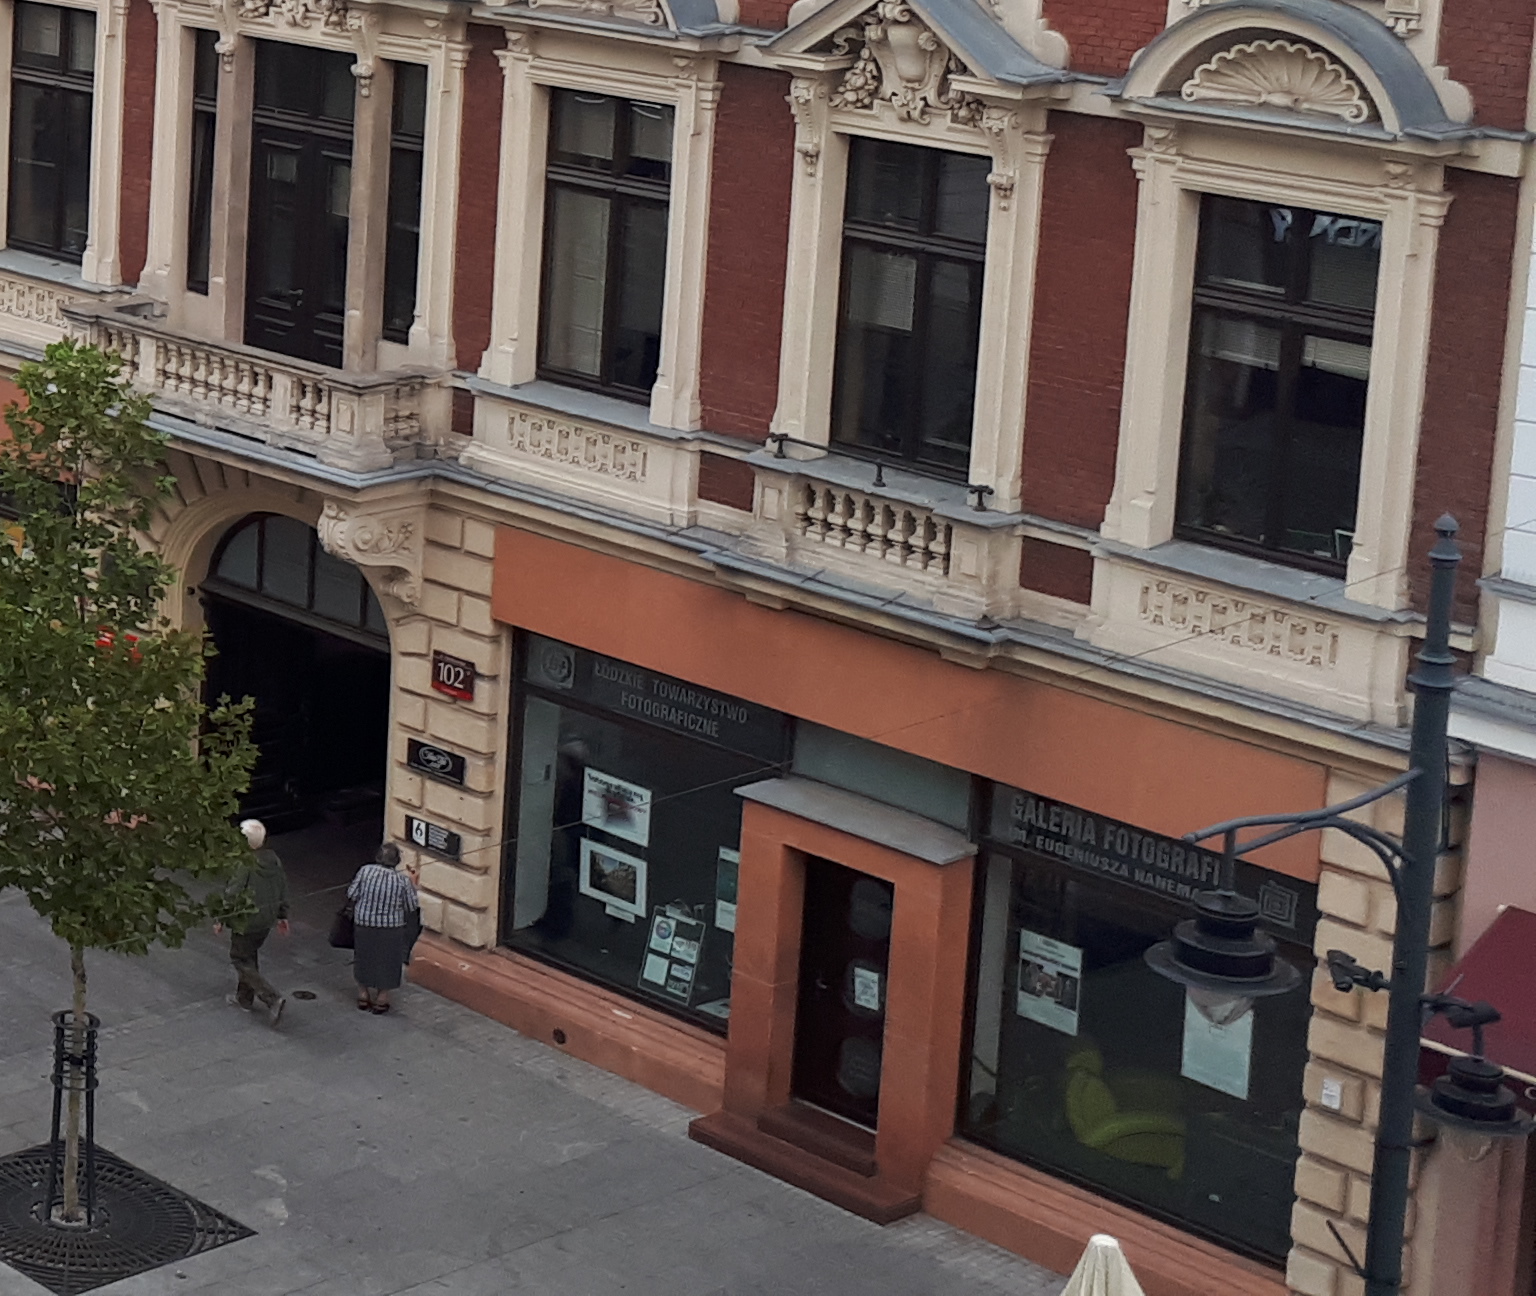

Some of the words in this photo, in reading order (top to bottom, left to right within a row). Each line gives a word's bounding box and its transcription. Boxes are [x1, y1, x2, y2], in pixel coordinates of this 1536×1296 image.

[437, 662, 465, 689] 102
[594, 660, 644, 691] ŁÓDZKIE
[652, 679, 748, 724] TOWARZYSTWO
[620, 690, 720, 739] FOTOGRAFICZNE
[414, 822, 424, 838] 6
[1010, 793, 1097, 846] GALERIA
[1035, 835, 1130, 878] EUGENIUSZA
